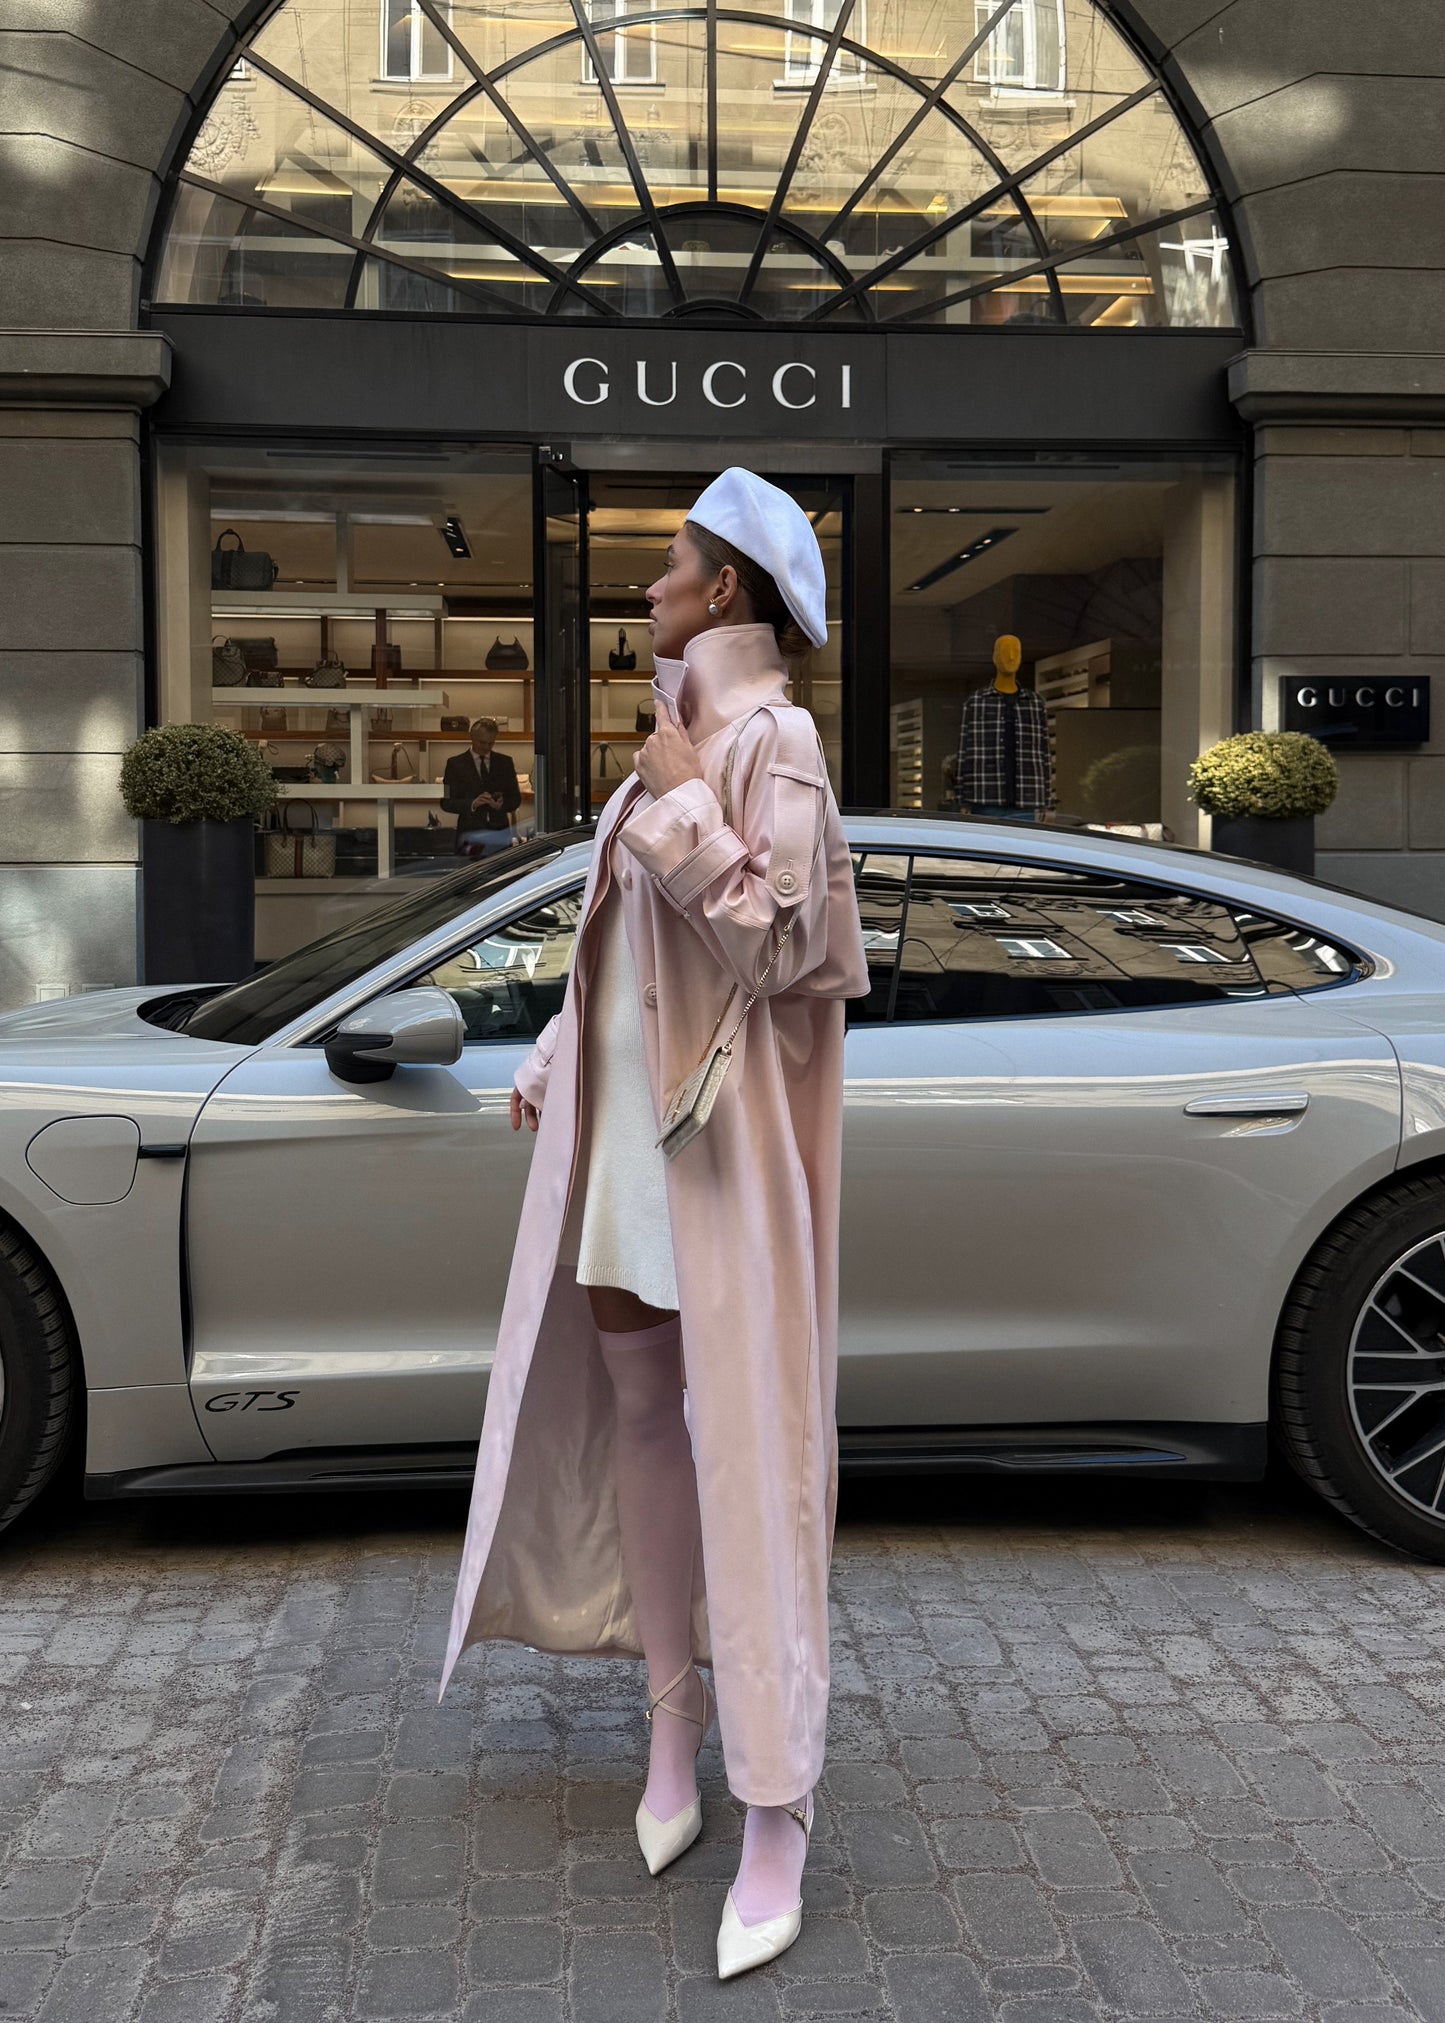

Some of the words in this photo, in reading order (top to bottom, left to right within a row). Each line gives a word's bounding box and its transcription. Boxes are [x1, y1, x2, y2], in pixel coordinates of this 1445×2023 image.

[563, 357, 851, 409] GUCCI
[1297, 686, 1419, 708] GUCCI
[205, 1391, 301, 1412] GTS
